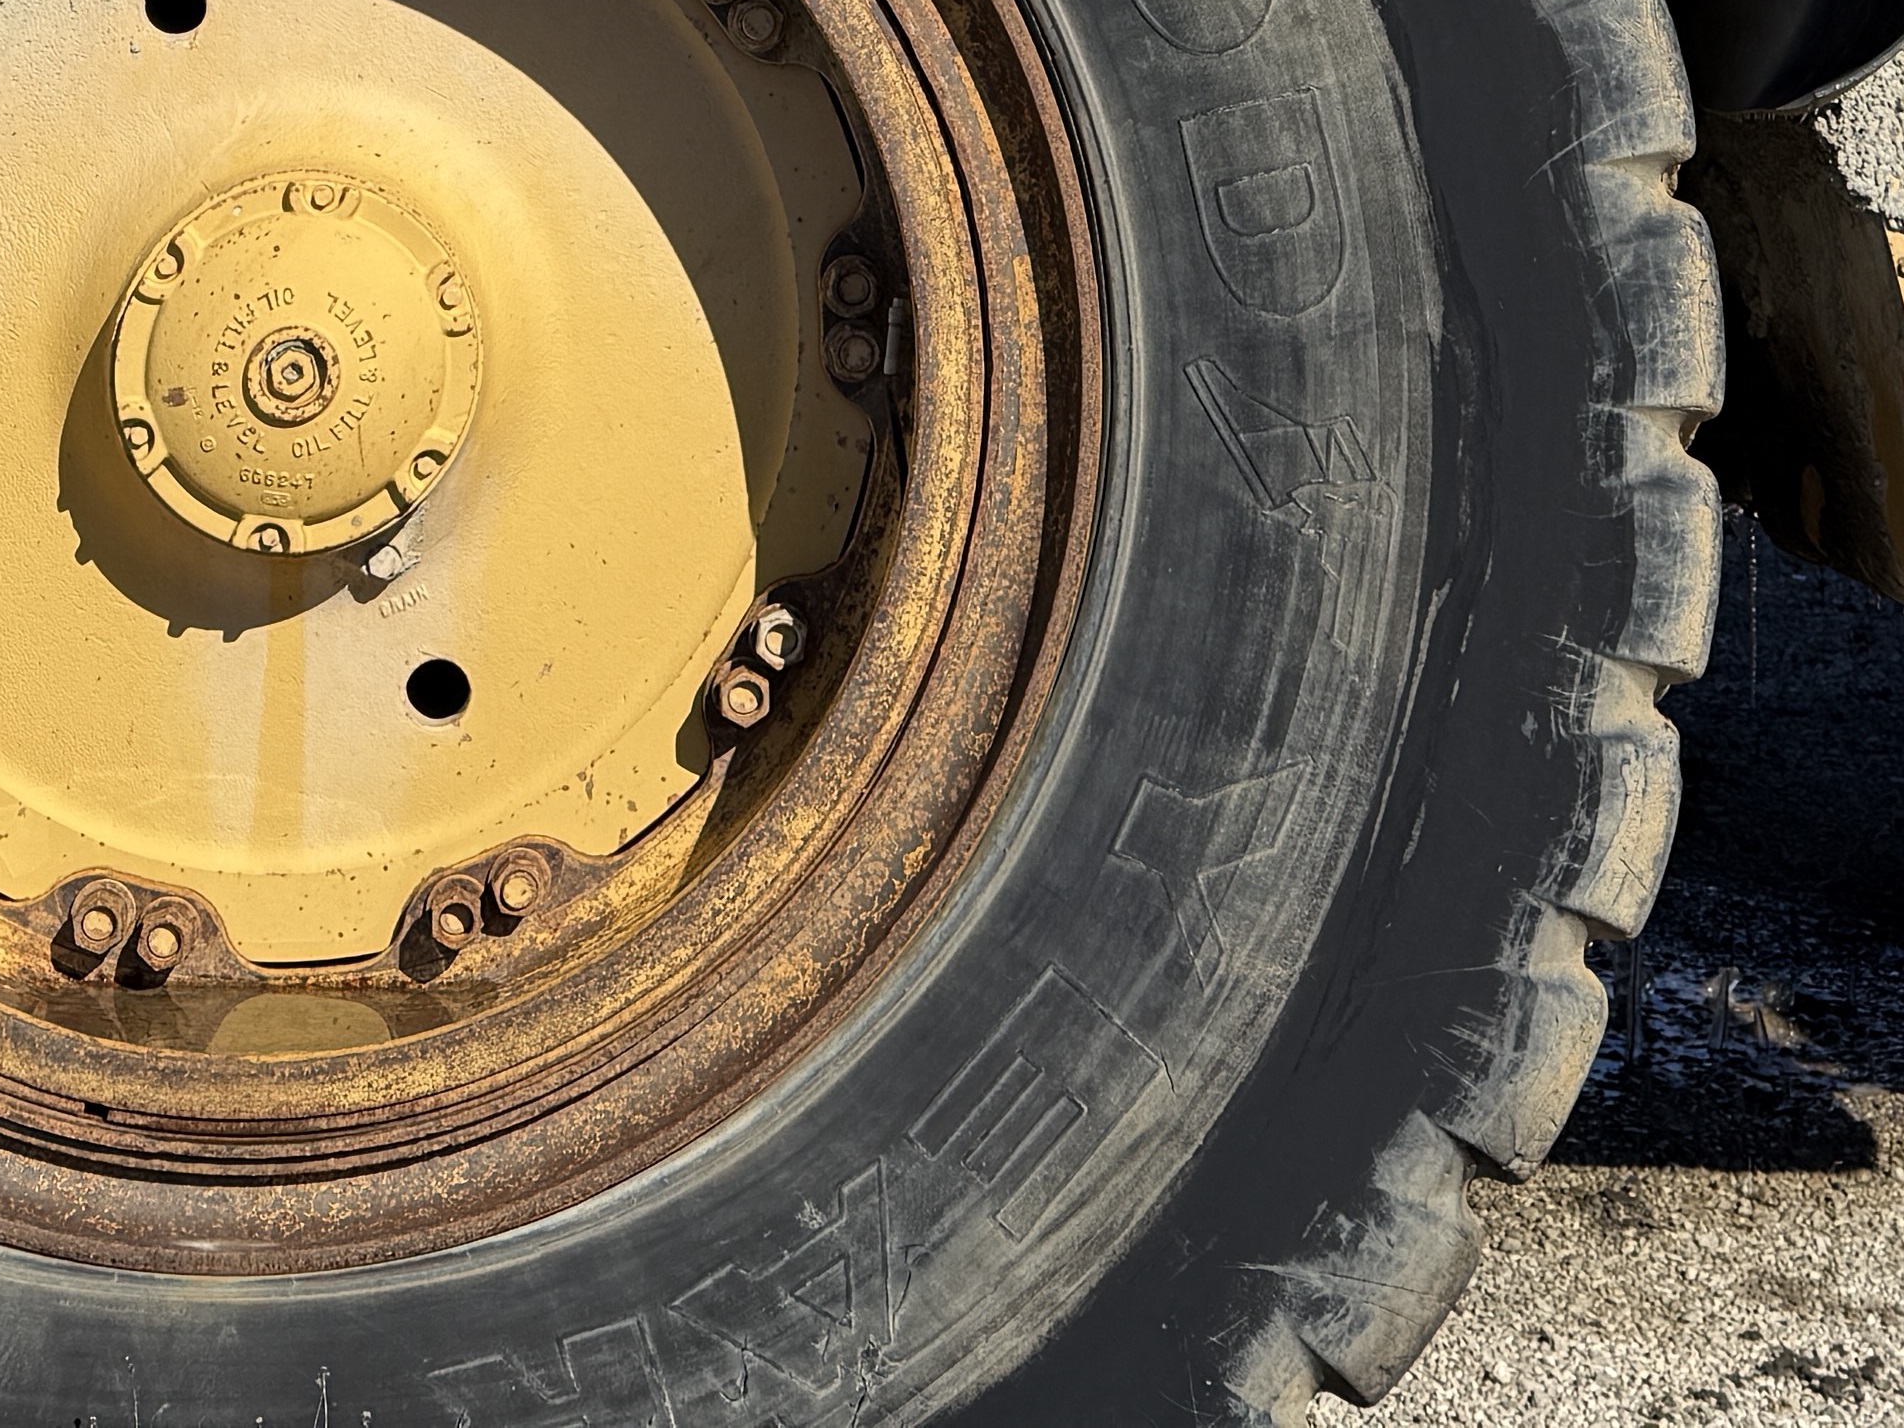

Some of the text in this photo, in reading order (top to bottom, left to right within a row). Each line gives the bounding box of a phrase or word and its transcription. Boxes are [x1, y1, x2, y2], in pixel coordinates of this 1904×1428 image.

[257, 287, 296, 312] OIL
[327, 292, 378, 363] LEVEL
[211, 384, 267, 455] LEVEL
[329, 392, 375, 442] FILL
[291, 435, 332, 460] OIL
